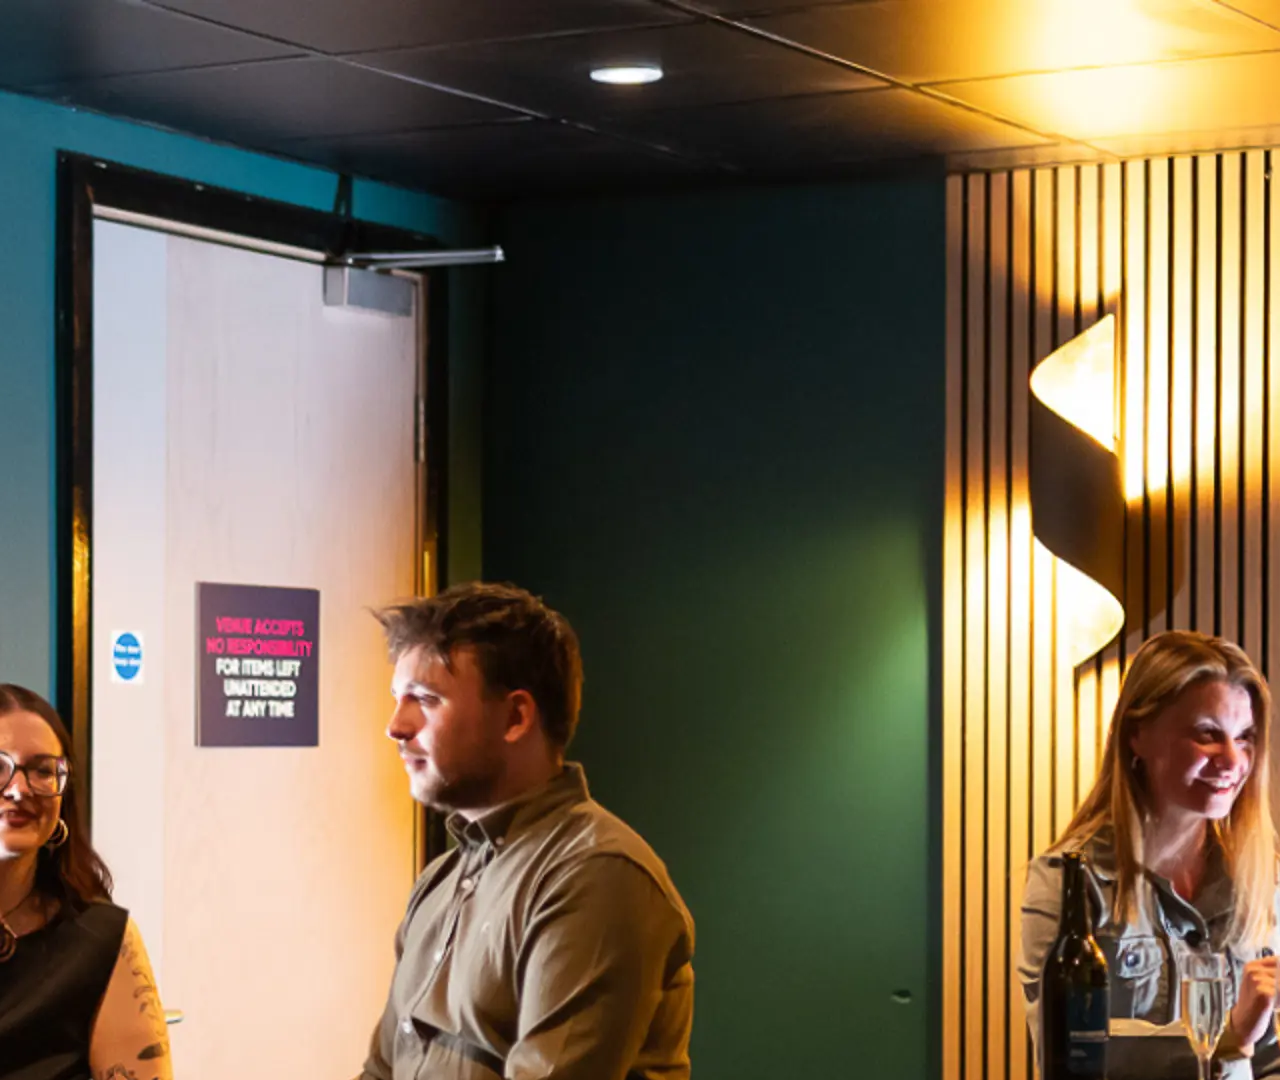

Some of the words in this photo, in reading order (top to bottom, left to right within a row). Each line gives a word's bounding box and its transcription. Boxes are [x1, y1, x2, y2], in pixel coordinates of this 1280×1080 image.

[216, 617, 252, 634] VENUE
[254, 619, 305, 636] ACCEPTS
[206, 637, 224, 654] NO
[226, 639, 312, 656] RESPONSIBILITY
[216, 658, 239, 675] FOR
[242, 659, 274, 676] ITEMS
[276, 659, 301, 677] LEFT
[224, 680, 296, 697] UNATTENDED
[225, 700, 241, 717] AT
[243, 701, 267, 717] ANY
[268, 701, 294, 718] TIME
